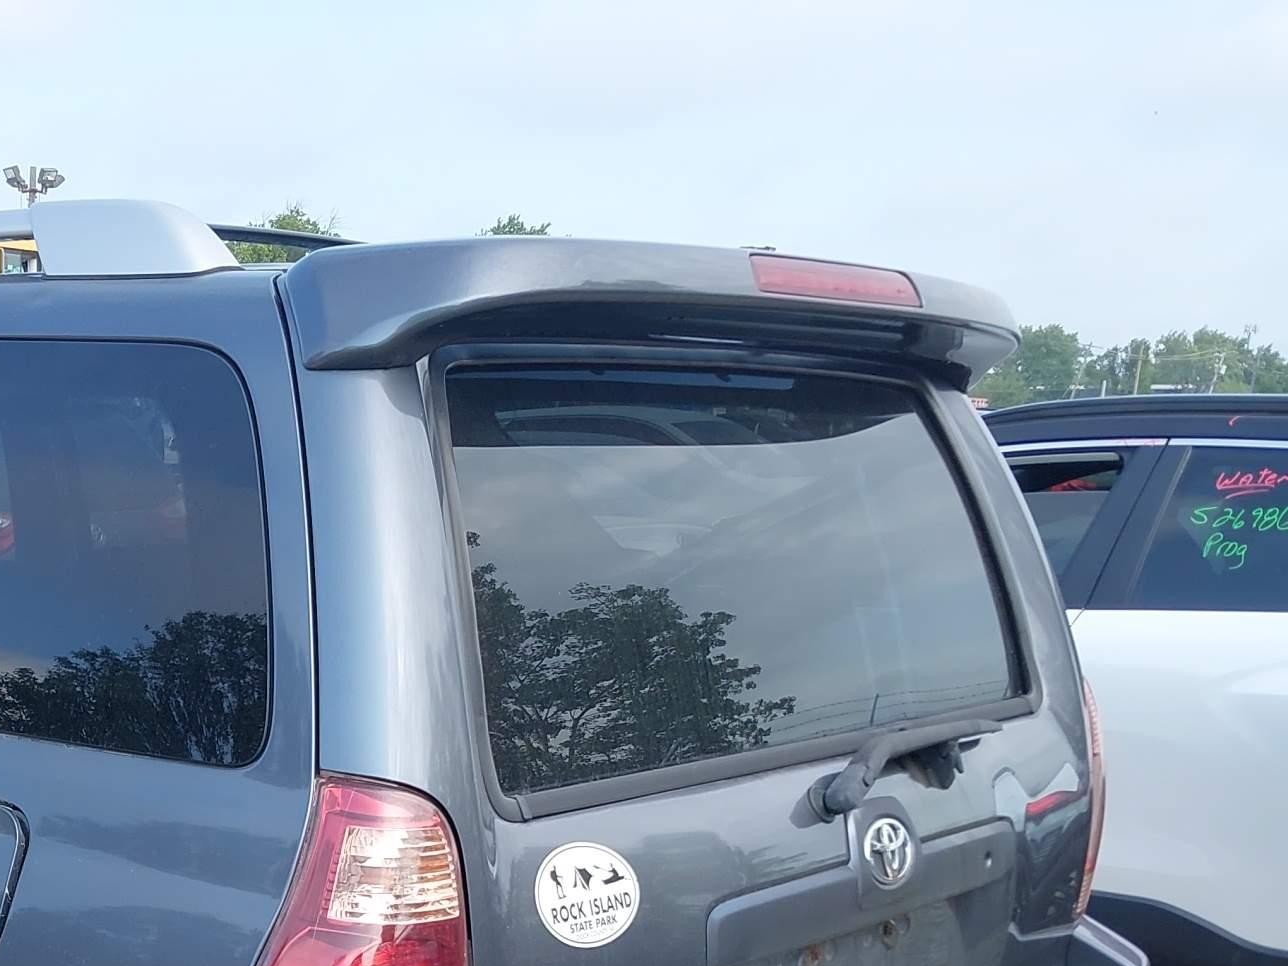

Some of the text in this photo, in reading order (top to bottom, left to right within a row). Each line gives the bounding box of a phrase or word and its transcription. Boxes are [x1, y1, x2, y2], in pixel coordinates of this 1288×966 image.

[1202, 532, 1248, 570] Prog
[551, 891, 632, 925] ROCK ISLAND
[570, 920, 594, 934] STATE
[595, 914, 618, 929] PARK
